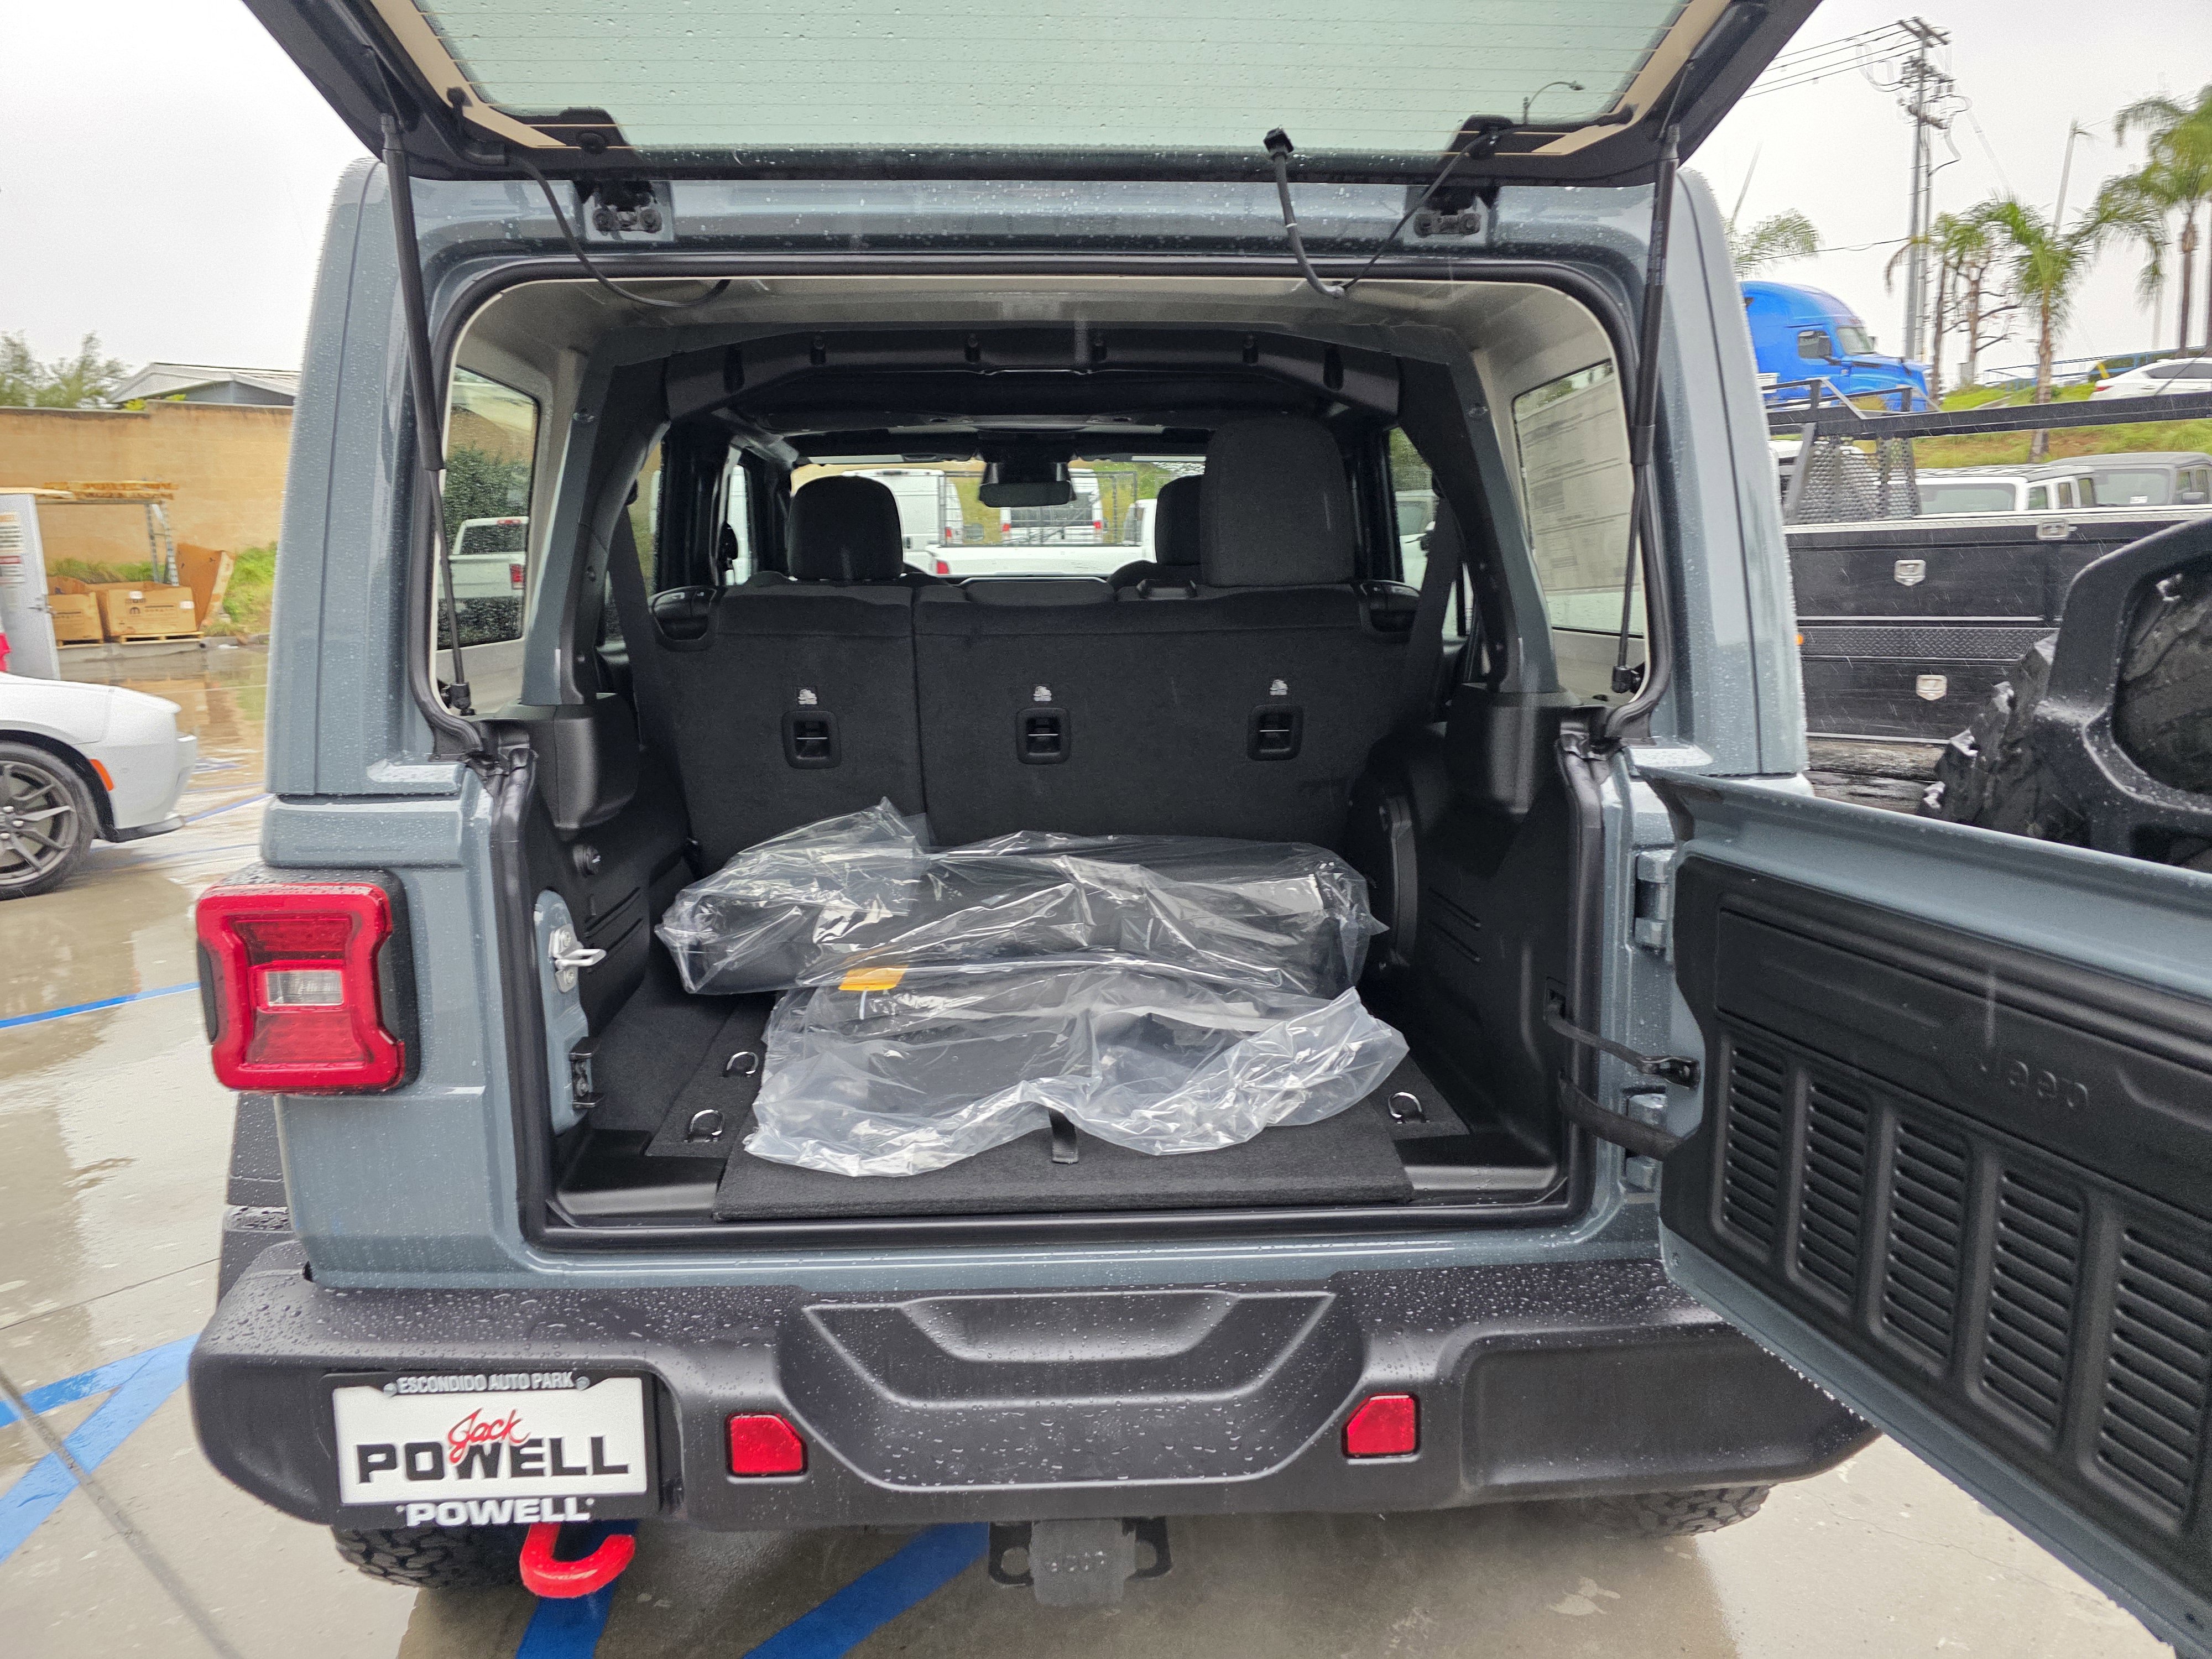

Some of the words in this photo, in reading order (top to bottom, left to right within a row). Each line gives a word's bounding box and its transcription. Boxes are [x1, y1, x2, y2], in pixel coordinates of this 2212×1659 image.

[396, 1374, 487, 1394] ESCONDIDO
[488, 1373, 531, 1391] AUTO
[530, 1371, 574, 1389] PARK
[447, 1408, 529, 1464] Jack
[355, 1436, 629, 1485] POWELL
[406, 1498, 591, 1527] POWELL
